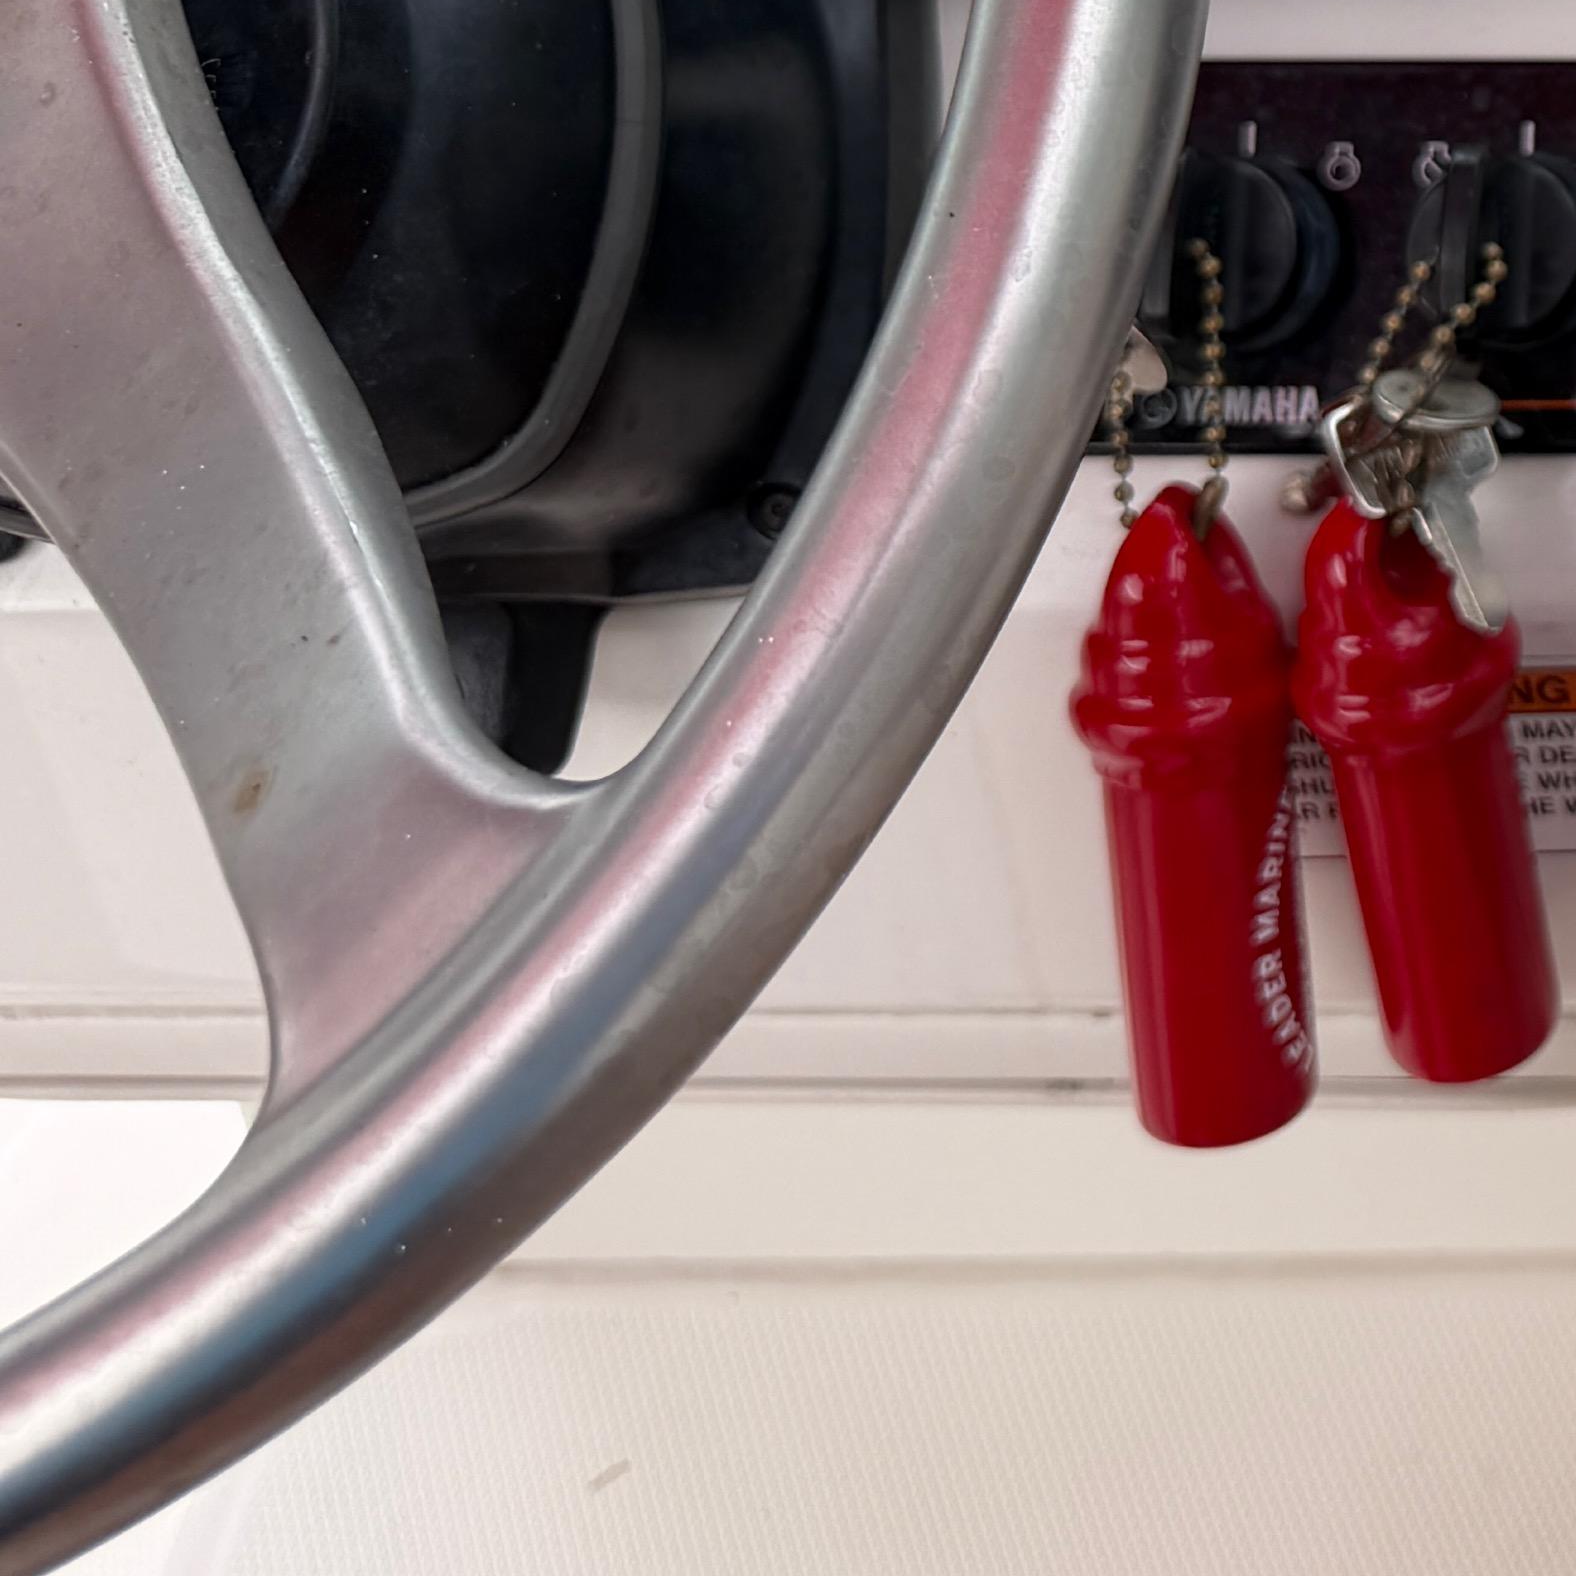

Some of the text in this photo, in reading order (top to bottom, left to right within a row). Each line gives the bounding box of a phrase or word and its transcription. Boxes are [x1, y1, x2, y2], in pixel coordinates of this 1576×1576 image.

[1180, 385, 1320, 424] YAMAHA
[1521, 720, 1576, 739] MAY
[1529, 796, 1555, 815] HE
